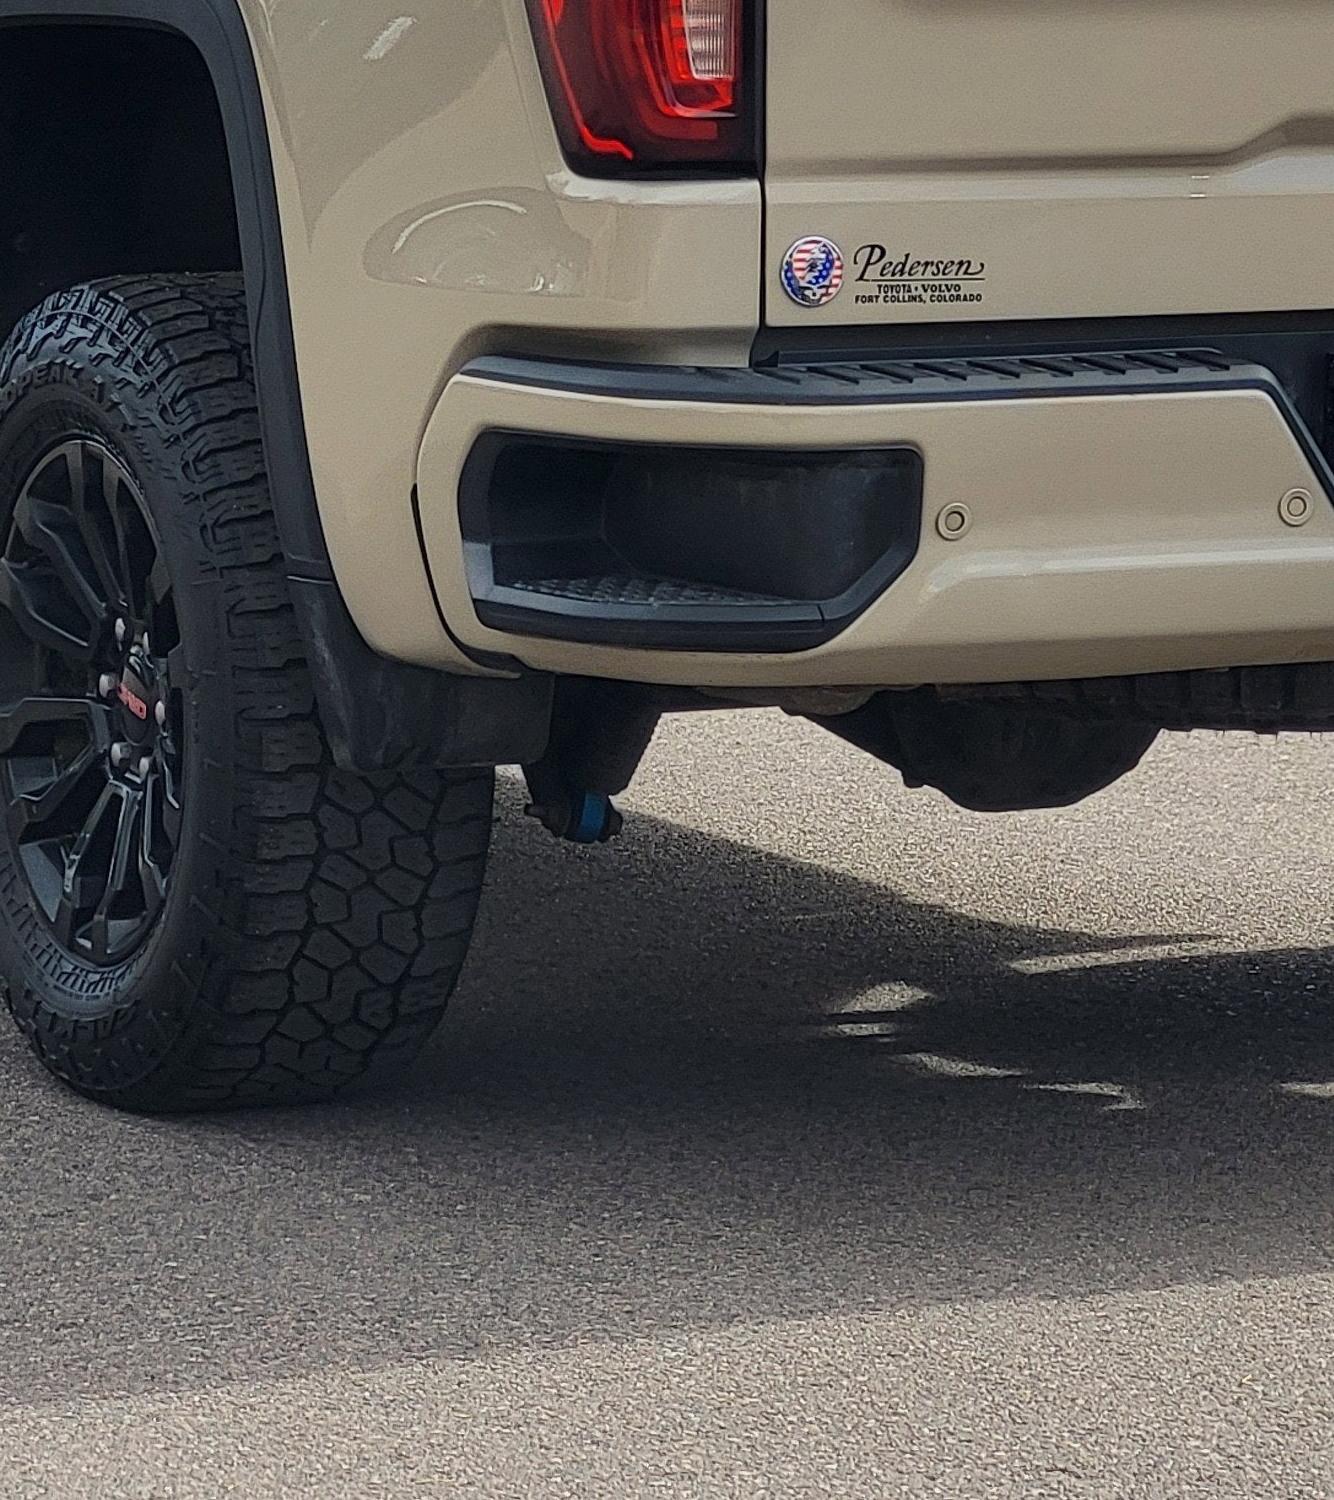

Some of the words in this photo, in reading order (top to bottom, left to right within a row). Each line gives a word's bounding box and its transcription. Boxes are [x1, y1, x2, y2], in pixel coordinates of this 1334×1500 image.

[853, 244, 985, 282] Pedersen
[877, 284, 912, 294] TOYOTA
[921, 283, 961, 293] VOLVO
[854, 295, 880, 304] FORT
[883, 294, 927, 304] COLLINS,
[930, 293, 983, 303] COLORADO
